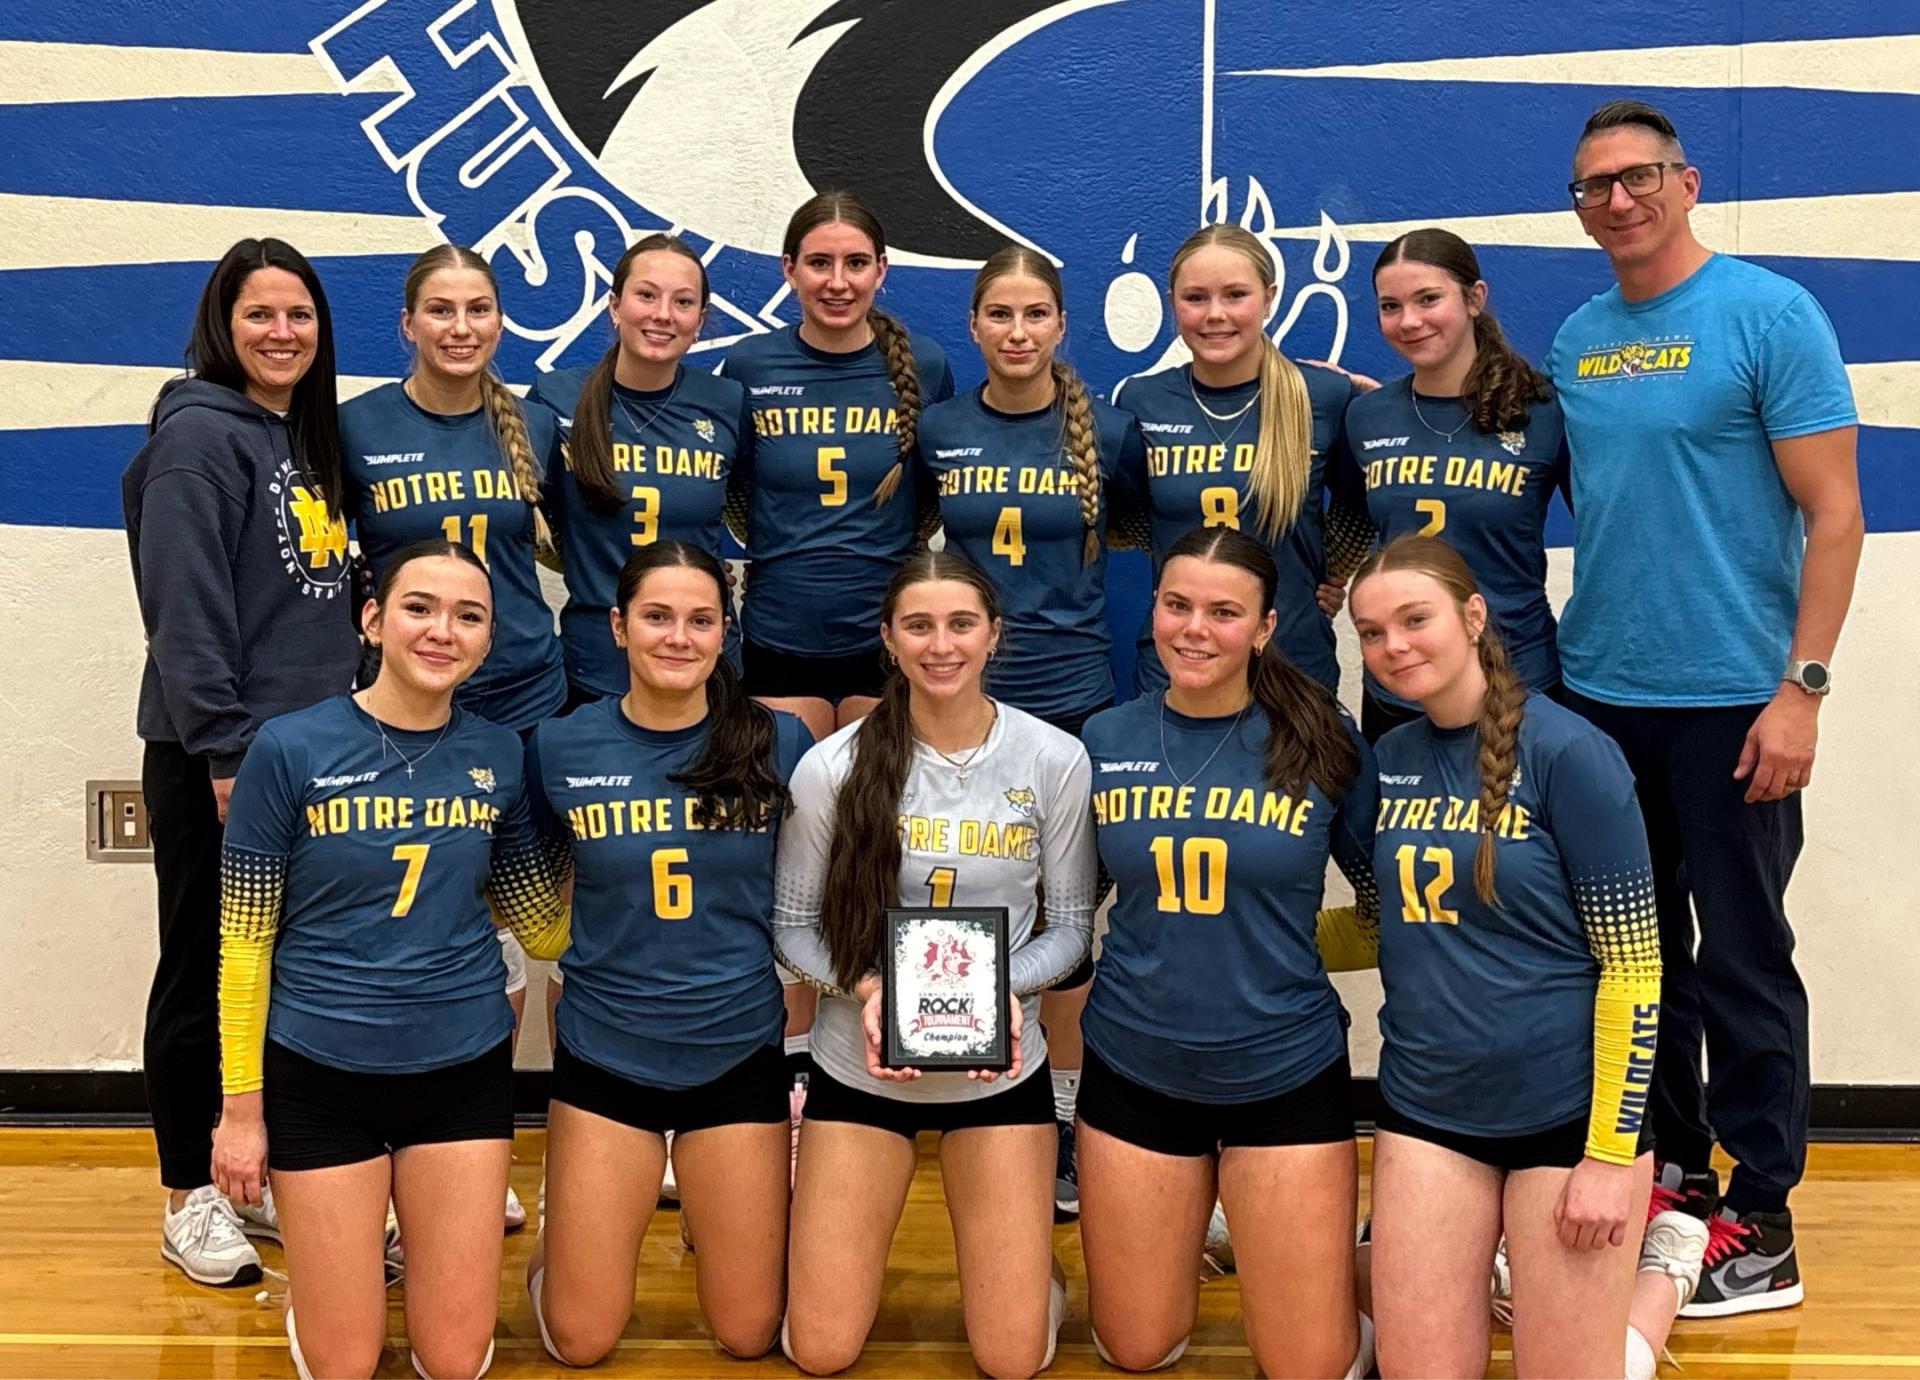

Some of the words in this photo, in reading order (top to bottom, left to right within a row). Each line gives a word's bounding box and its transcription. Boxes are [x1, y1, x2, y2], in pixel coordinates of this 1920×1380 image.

[752, 406, 837, 437] NOTRE
[845, 406, 901, 435] DAM
[560, 443, 646, 473] NRE
[656, 446, 726, 480] DAME
[817, 447, 847, 506] 5
[1018, 466, 1079, 496] DAM
[1444, 456, 1531, 497] DAME
[369, 470, 466, 514] NOTRE
[473, 469, 522, 501] DA
[1201, 486, 1239, 530] 8
[630, 486, 661, 546] 3
[992, 506, 1026, 566] 4
[440, 514, 490, 574] 11
[306, 796, 414, 838] NOTRE
[567, 797, 673, 841] NOTRE
[685, 797, 770, 833] DE
[1093, 785, 1197, 826] NOTRE
[1204, 786, 1314, 837] DAME
[1376, 797, 1442, 834] OTRE
[896, 814, 950, 853] TRE
[959, 819, 1037, 862] DAME
[390, 844, 430, 917] 7
[651, 848, 694, 919] 6
[924, 866, 957, 908] 1
[1150, 836, 1228, 914] 10
[1395, 844, 1459, 925] 12
[918, 998, 970, 1014] ROCK
[923, 1031, 969, 1043] Champion
[1615, 1003, 1660, 1134] WILDCATS
